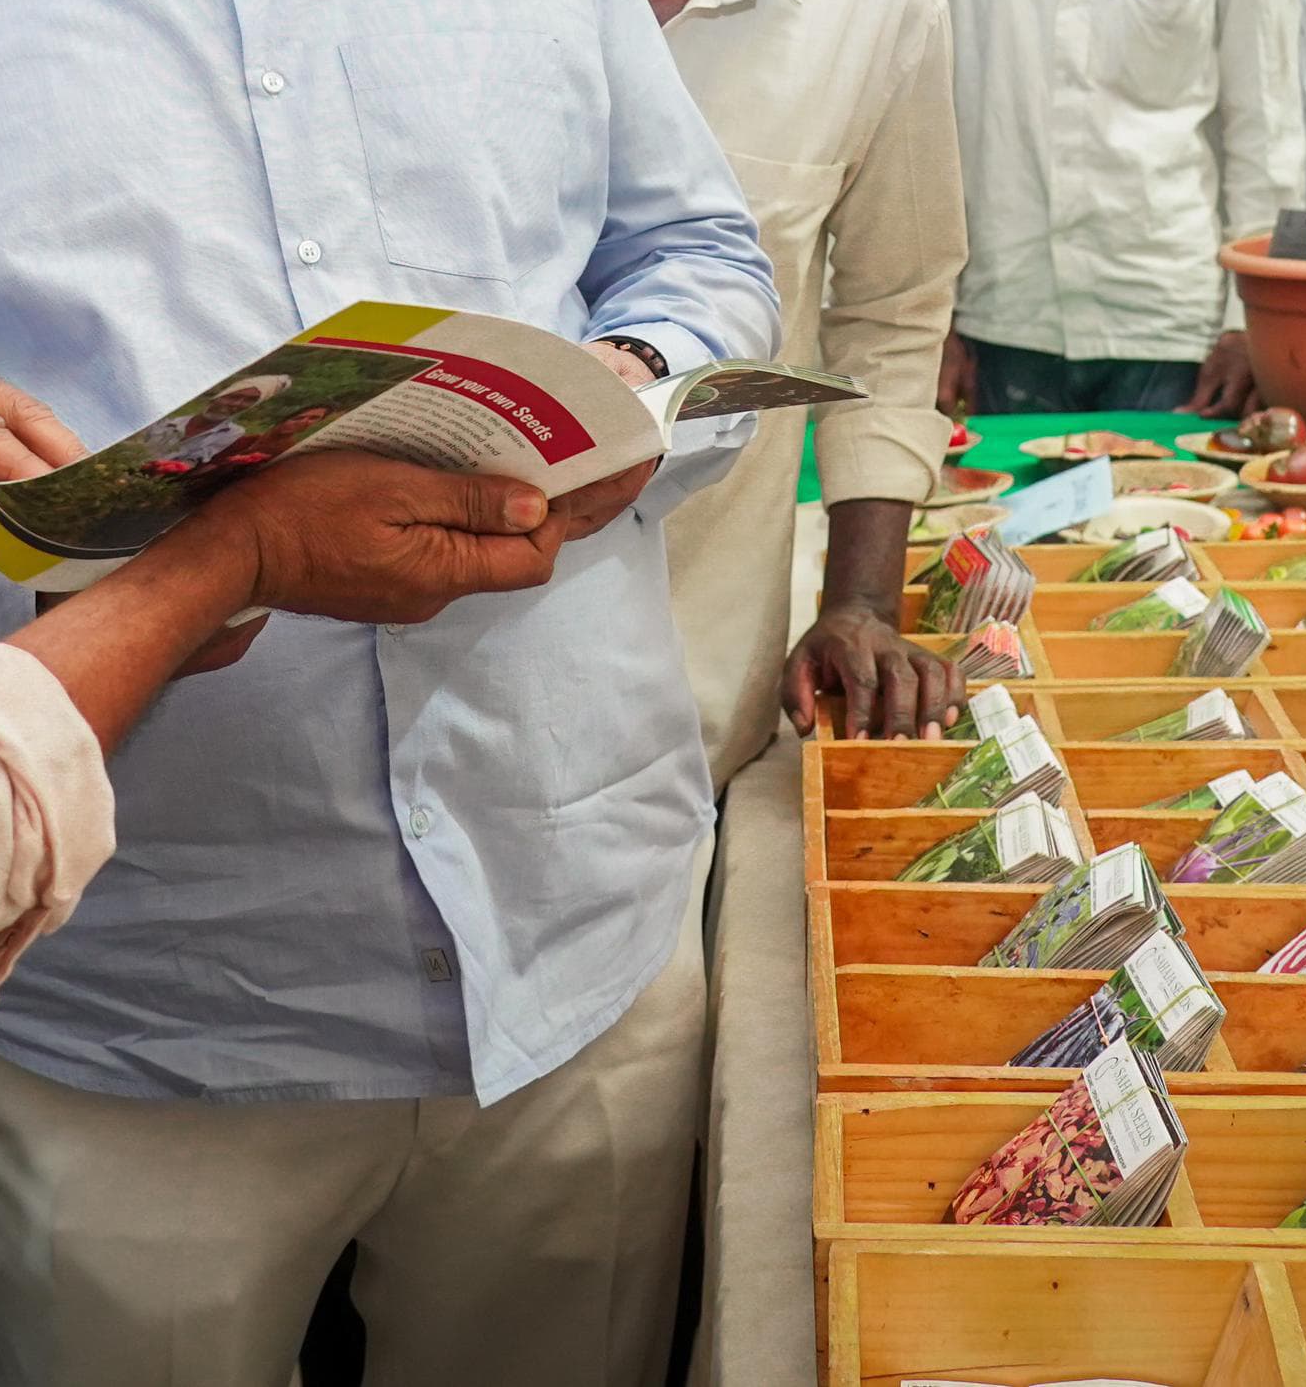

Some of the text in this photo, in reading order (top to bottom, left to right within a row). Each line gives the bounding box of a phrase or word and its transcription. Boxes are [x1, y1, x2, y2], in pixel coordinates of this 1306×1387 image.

[425, 368, 462, 384] Grow
[454, 378, 490, 395] your
[486, 391, 517, 410] own
[512, 406, 553, 443] Seeds
[1172, 983, 1191, 1013] SEDS
[1132, 1107, 1155, 1147] SEEDS
